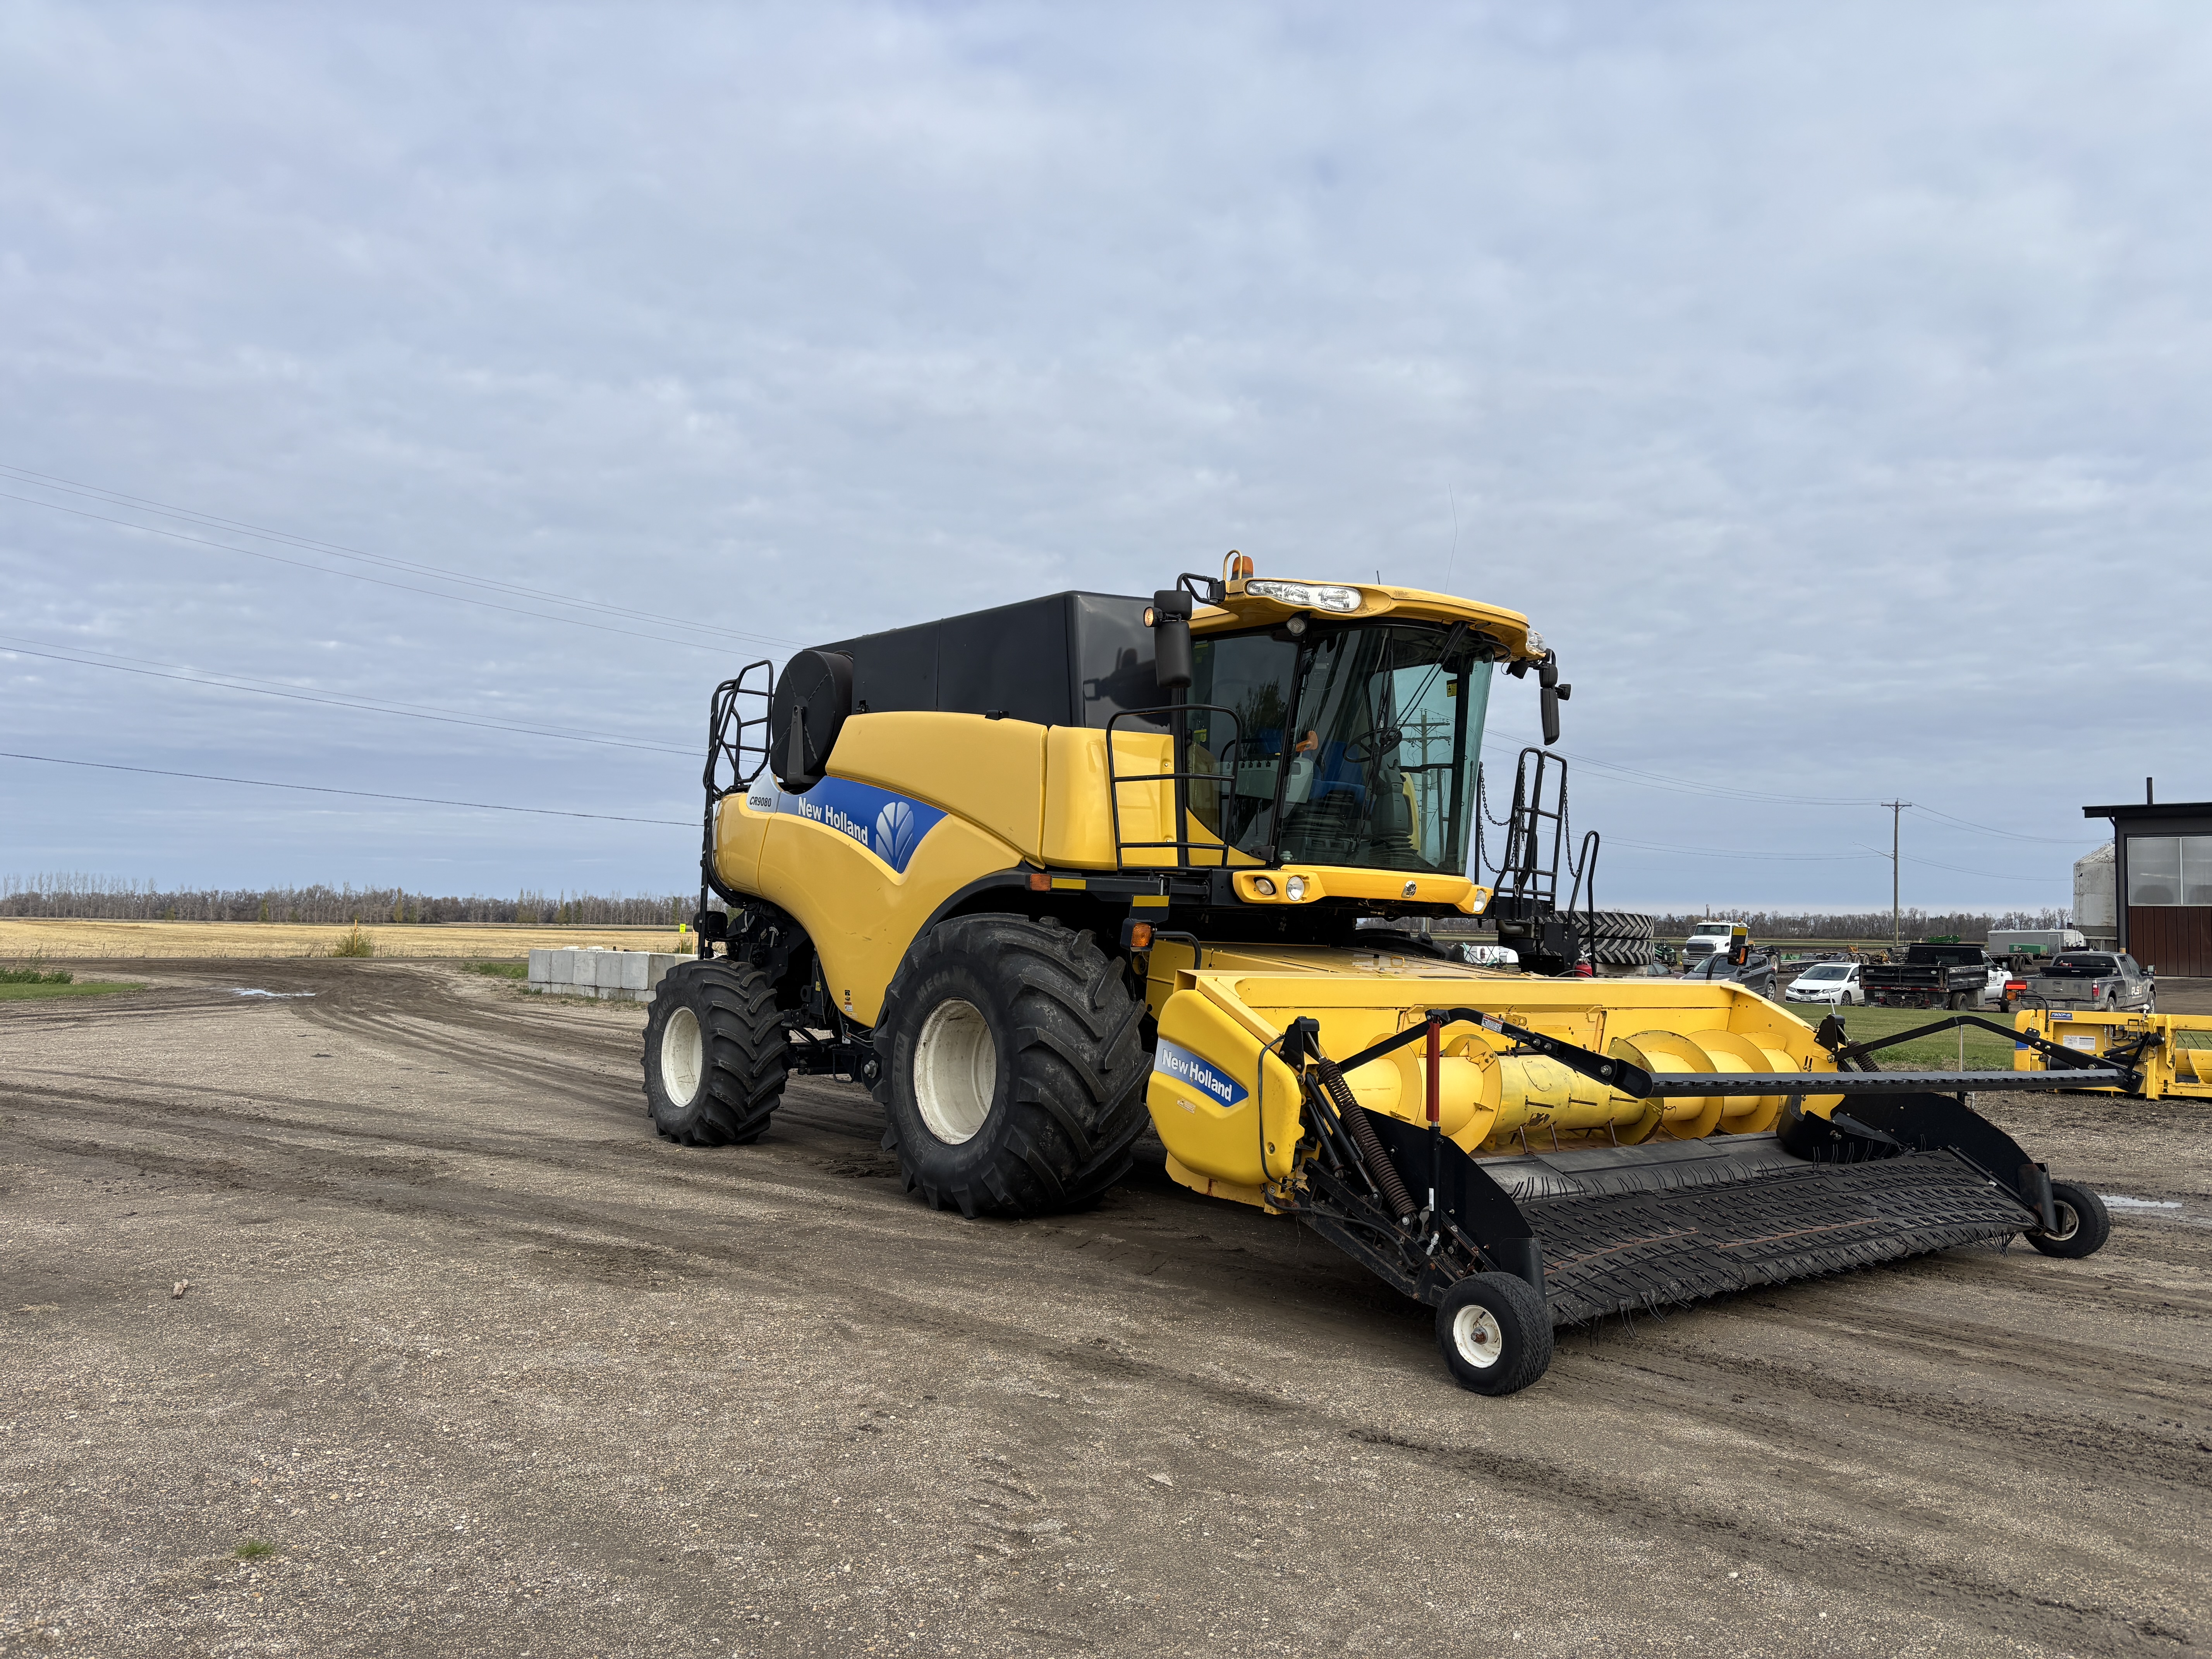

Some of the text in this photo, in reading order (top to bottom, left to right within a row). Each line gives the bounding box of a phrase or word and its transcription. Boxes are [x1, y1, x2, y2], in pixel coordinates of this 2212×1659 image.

[750, 796, 771, 807] CR9080
[798, 796, 868, 845] New Holland
[1162, 1048, 1232, 1102] New Holland
